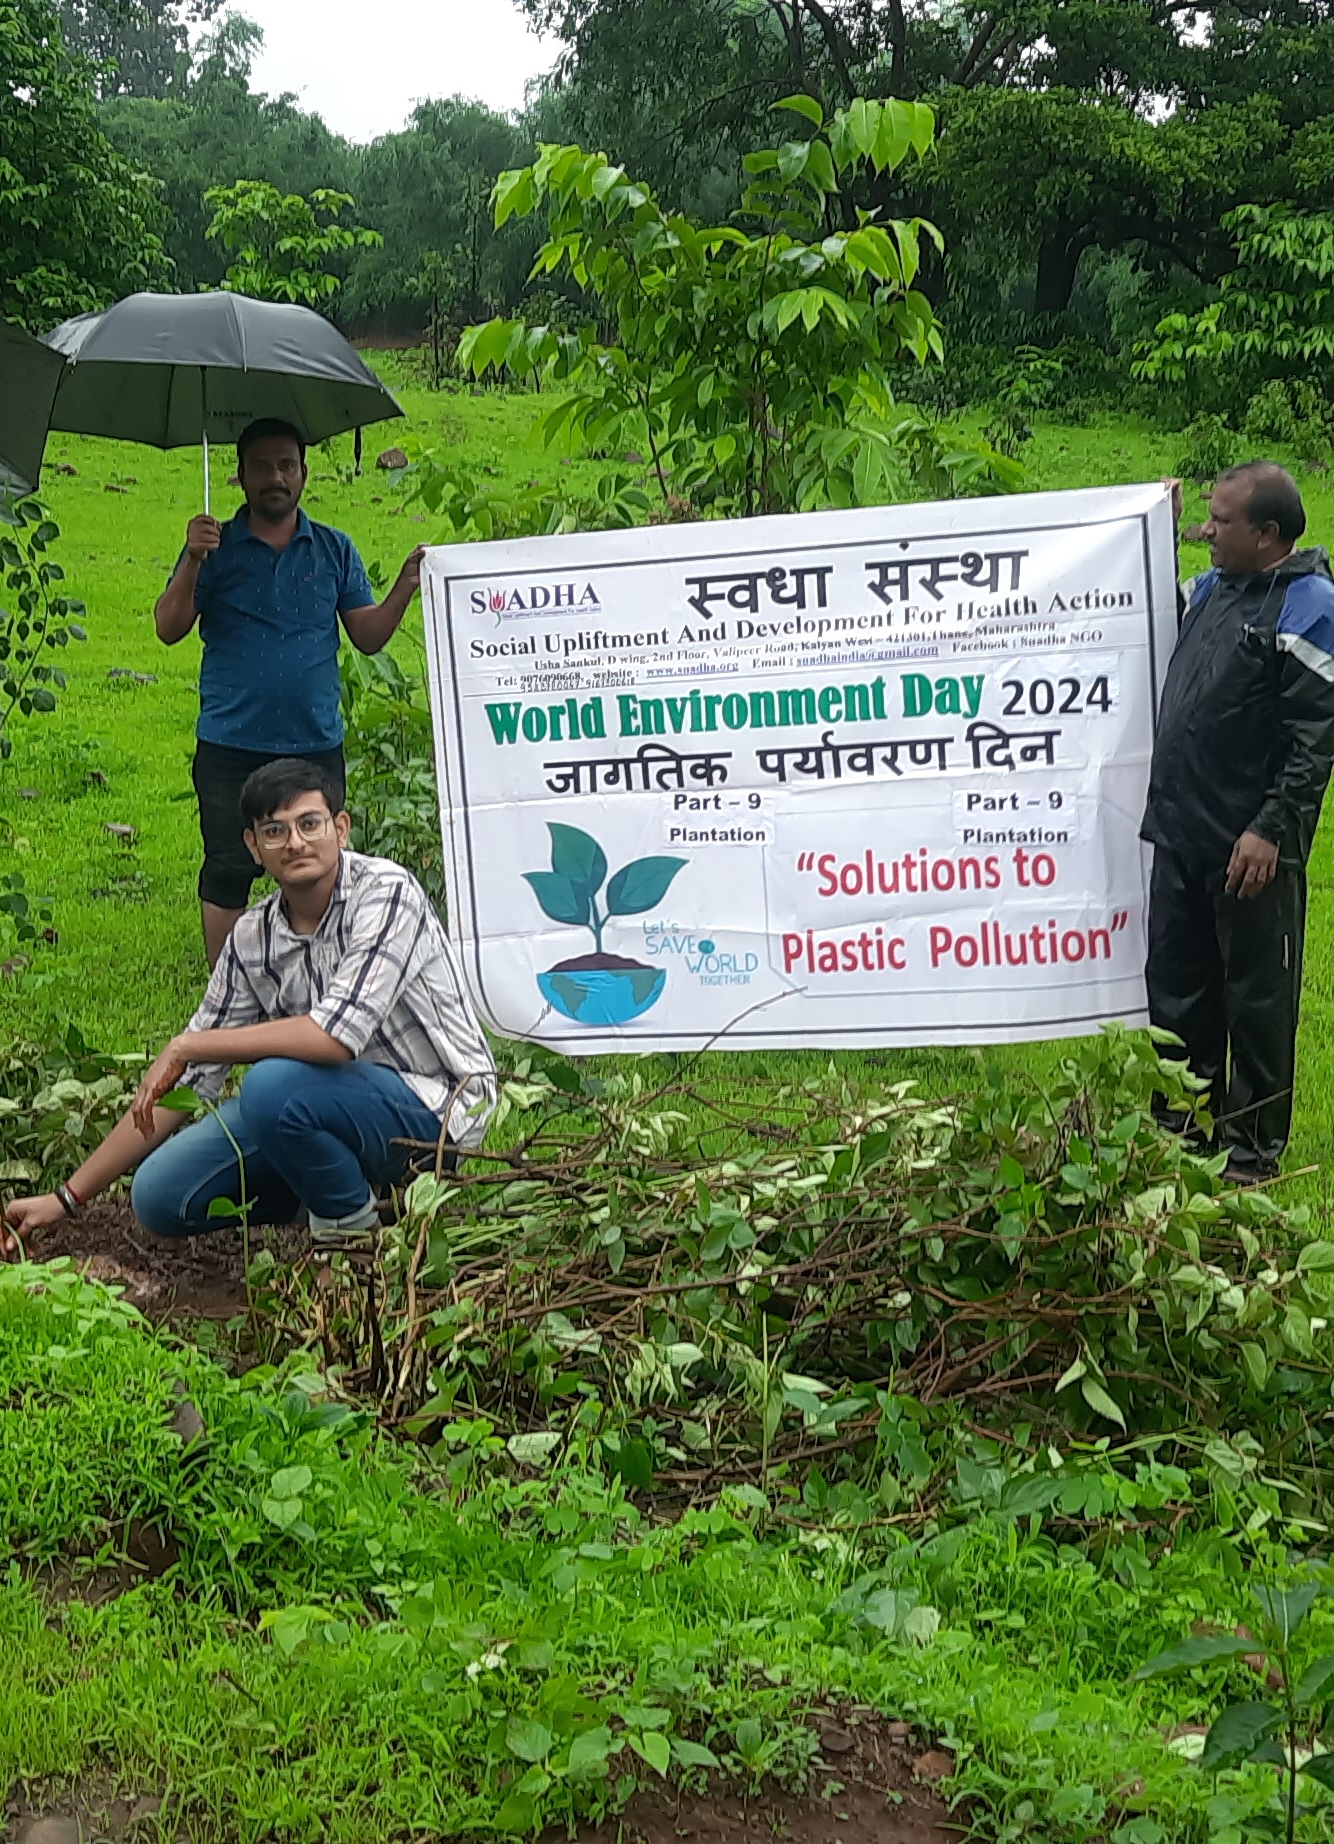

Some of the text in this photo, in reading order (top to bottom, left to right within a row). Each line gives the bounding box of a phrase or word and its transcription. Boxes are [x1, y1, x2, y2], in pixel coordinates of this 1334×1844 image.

[684, 541, 1030, 620] स्वधा संस्था
[470, 588, 1134, 659] Social Upliftment And Development For Health Action
[494, 676, 518, 687] Tel:
[752, 656, 786, 669] Email
[952, 637, 1009, 653] Facebook
[1070, 629, 1103, 643] NGO
[534, 659, 561, 671] Usha
[607, 655, 617, 665] D
[652, 651, 673, 662] 2nd
[801, 640, 842, 652] Kalyan
[483, 673, 1113, 746] World Environment Day 2024
[543, 721, 1062, 794] जागतिक पर्यावरण दिन
[673, 793, 722, 811] Part
[747, 792, 762, 810] 9
[966, 793, 1020, 811] Part
[1048, 791, 1064, 810] 9
[669, 827, 766, 842] Plantation
[963, 827, 1069, 844] Plantation
[1012, 848, 1057, 887] to
[645, 934, 697, 955] SAVE
[781, 927, 907, 974] Plastic
[684, 952, 759, 974] WORLD
[699, 973, 751, 987] TOGETHER
